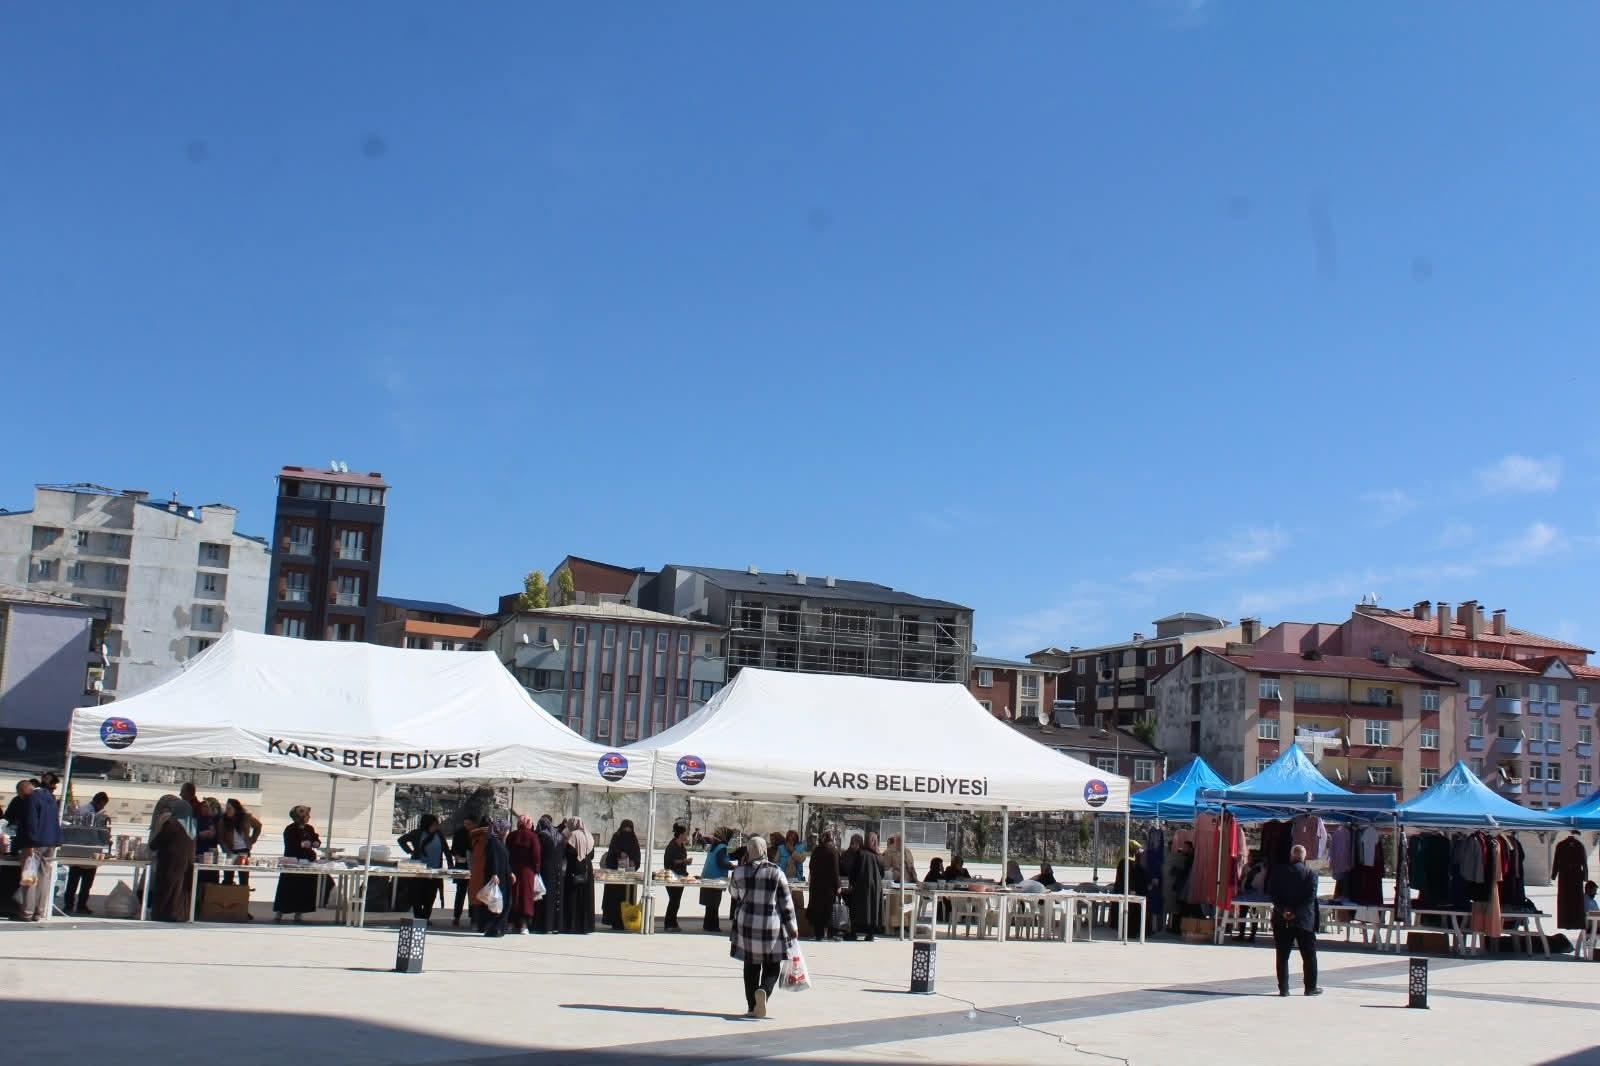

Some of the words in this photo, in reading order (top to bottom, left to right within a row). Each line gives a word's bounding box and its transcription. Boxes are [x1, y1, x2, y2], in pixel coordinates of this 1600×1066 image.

[269, 737, 334, 762] KARS
[342, 750, 481, 769] BELEDİYESİ
[813, 770, 869, 790] KARS
[875, 774, 988, 796] BELEDİYESİ
